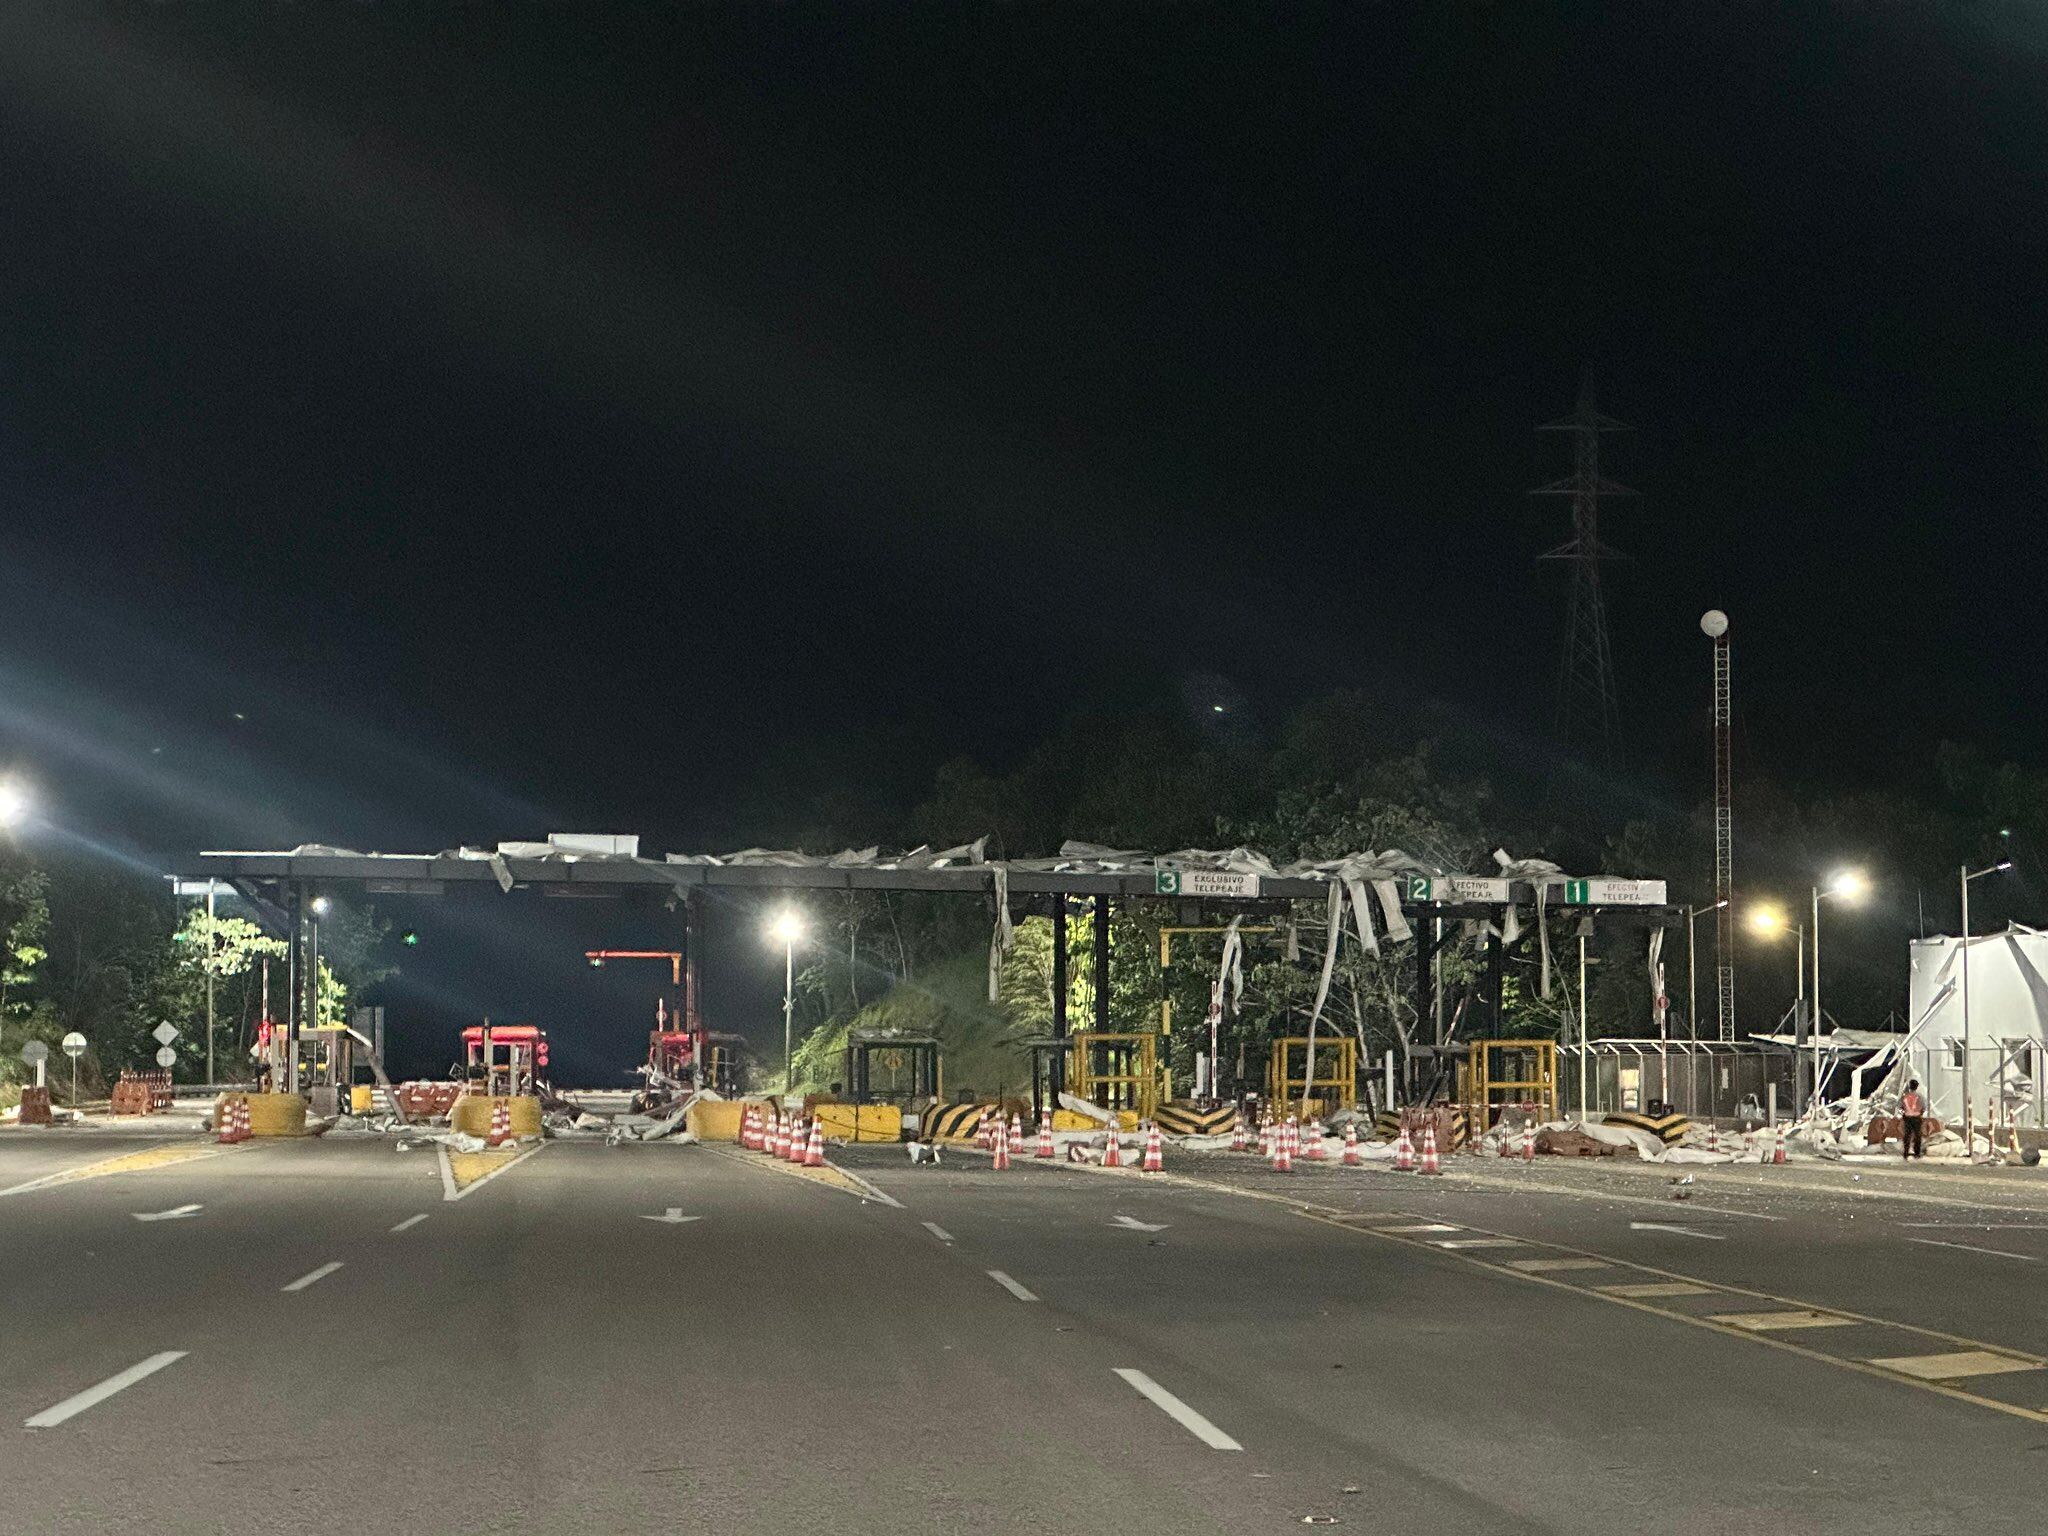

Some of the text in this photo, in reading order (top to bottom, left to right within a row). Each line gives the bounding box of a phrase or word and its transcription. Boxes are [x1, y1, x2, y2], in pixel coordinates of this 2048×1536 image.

[1161, 872, 1177, 892] 3
[1194, 875, 1244, 884] EXCLUSIVO
[1455, 881, 1489, 889] FECTIVO
[1194, 884, 1244, 893] TELEPEAJE
[1413, 878, 1427, 900] 2
[1574, 882, 1580, 902] 1
